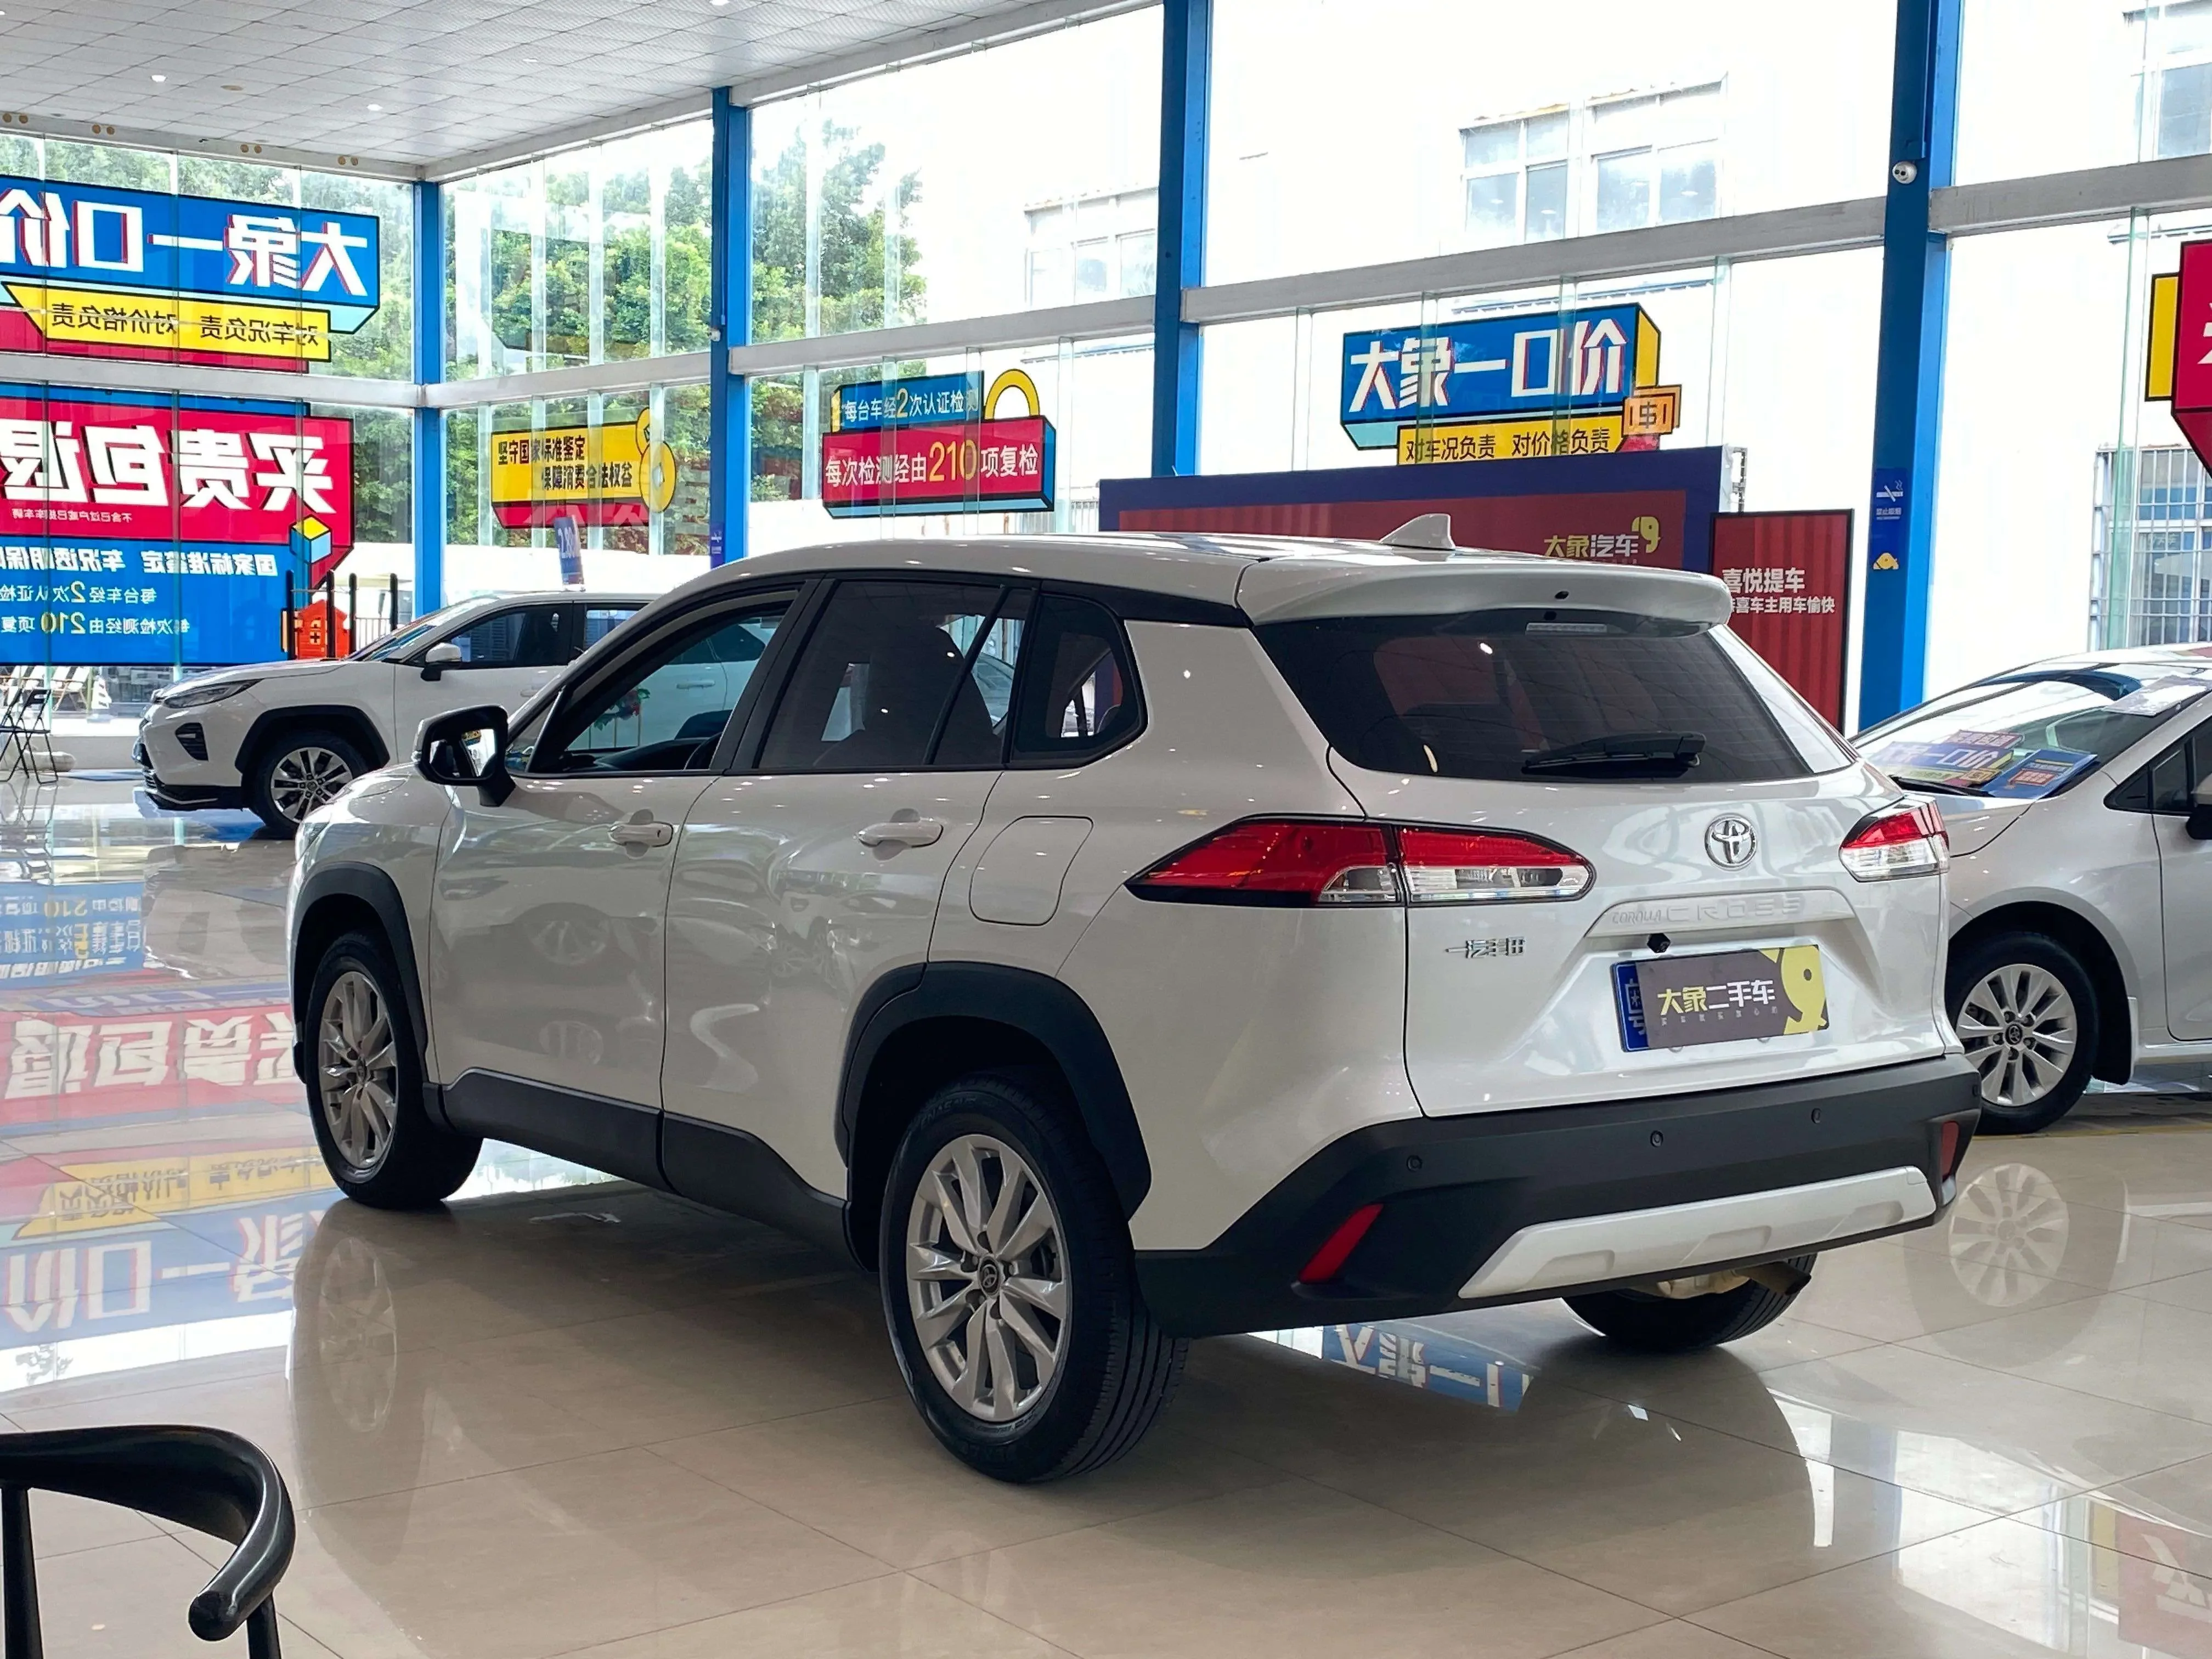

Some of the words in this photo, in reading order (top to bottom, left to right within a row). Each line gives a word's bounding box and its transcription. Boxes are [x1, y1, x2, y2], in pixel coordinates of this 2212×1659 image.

[1349, 318, 1627, 413] 大象一口价
[1406, 435, 1497, 462] 对车况负责
[1511, 428, 1611, 458] 对价格负责
[825, 439, 1039, 488] 每次检测经由210项复检
[1543, 534, 1639, 558] 大象汽车
[1722, 567, 1805, 594] 喜悦提车
[1611, 910, 1662, 926] COROLLA
[1666, 895, 1801, 922] CROSS
[1657, 980, 1776, 1015] 大象二手车
